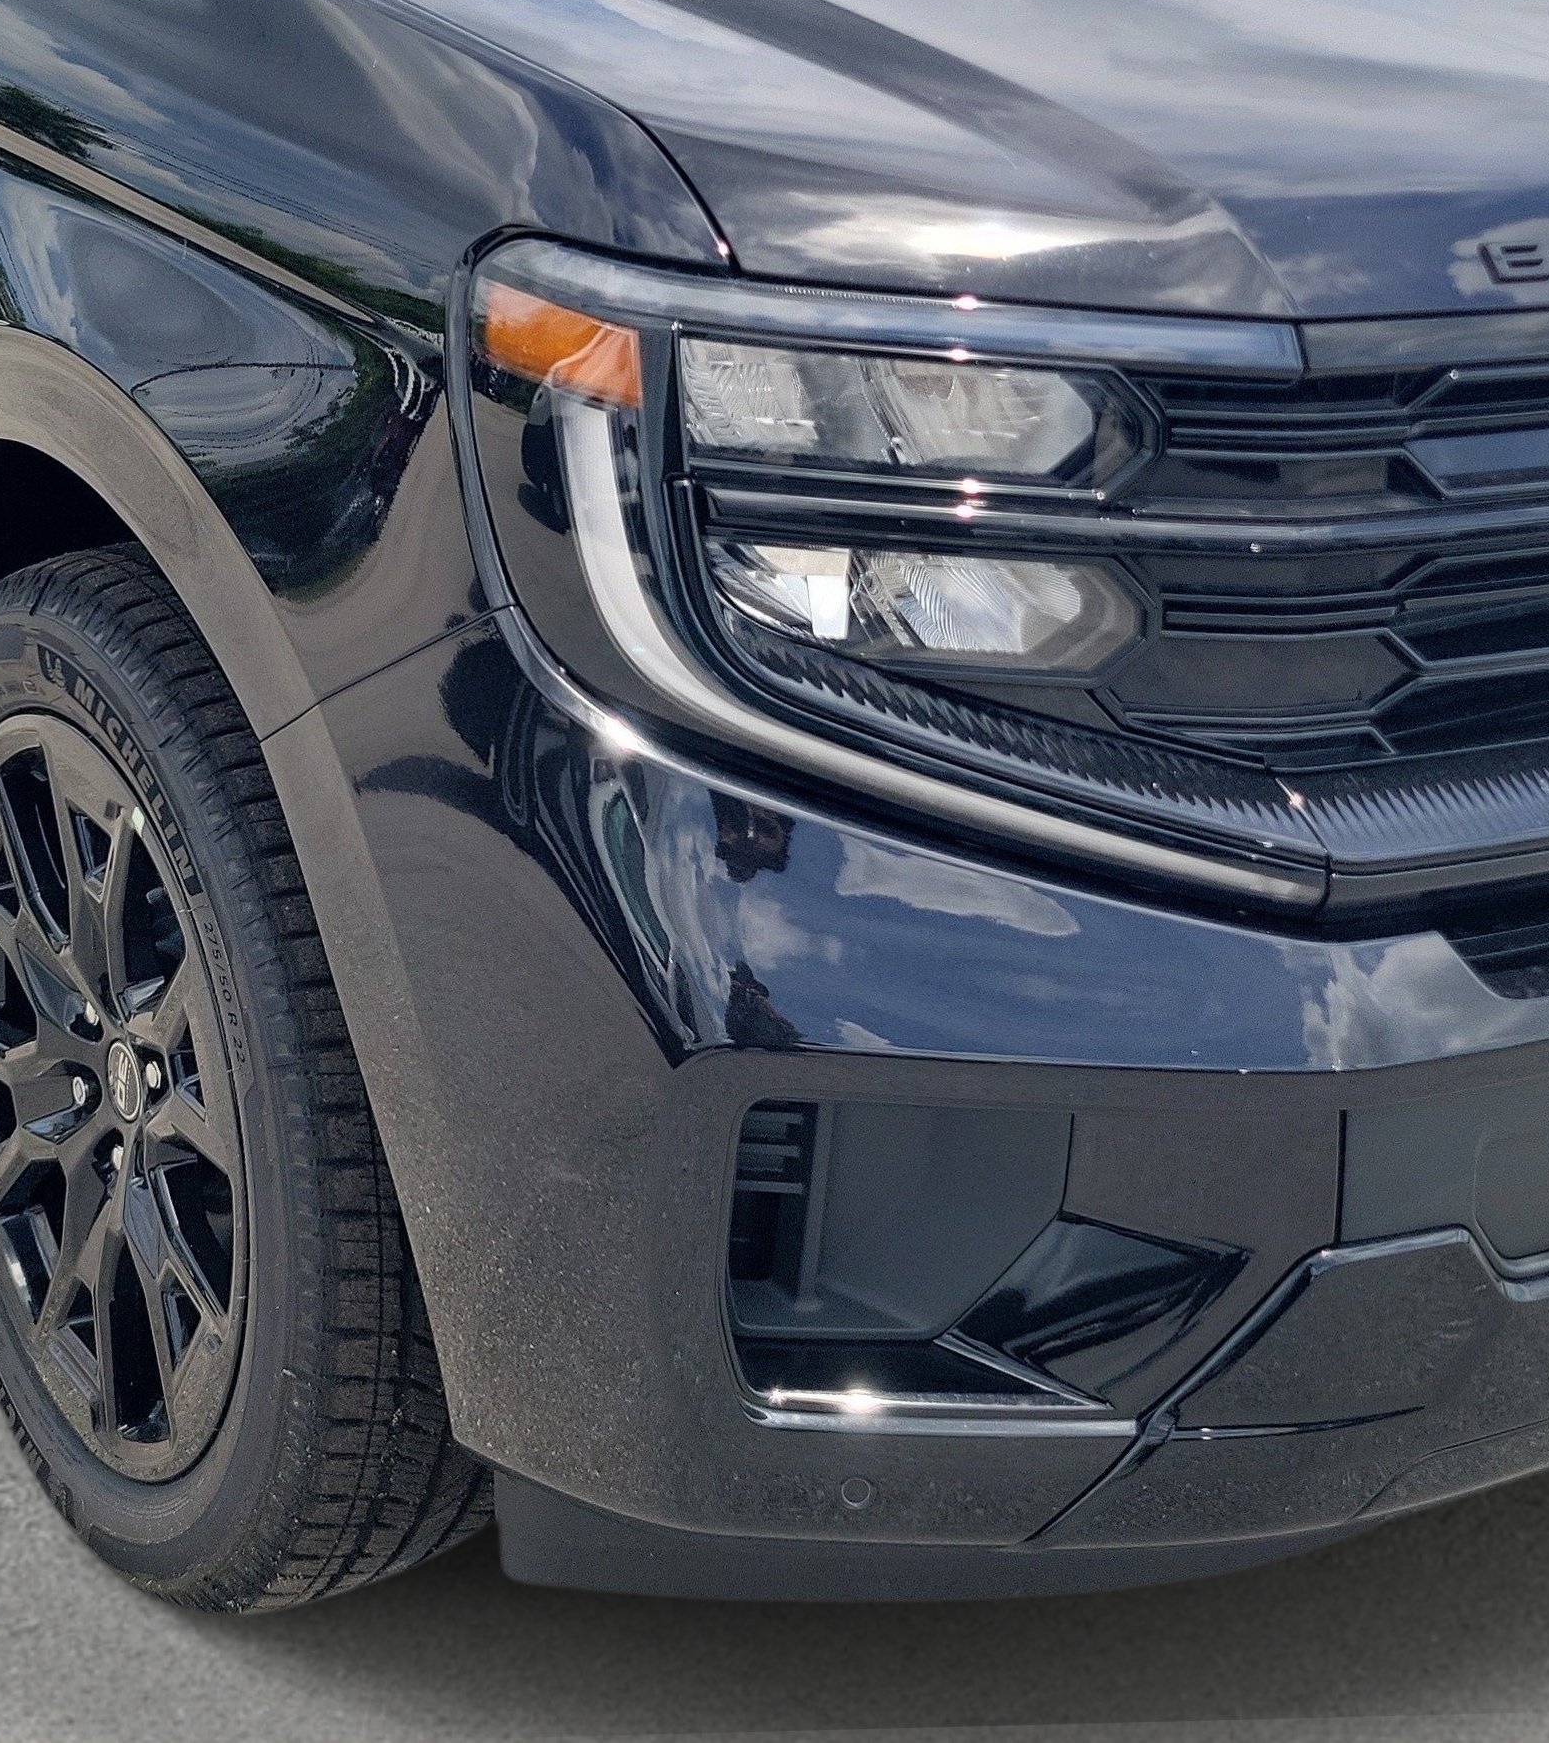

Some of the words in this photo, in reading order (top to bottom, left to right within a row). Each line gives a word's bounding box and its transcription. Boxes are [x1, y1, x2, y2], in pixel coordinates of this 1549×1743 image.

[74, 677, 195, 880] MICHELIN
[204, 922, 233, 1004] 275/50
[227, 1011, 238, 1027] R
[232, 1035, 246, 1064] 22
